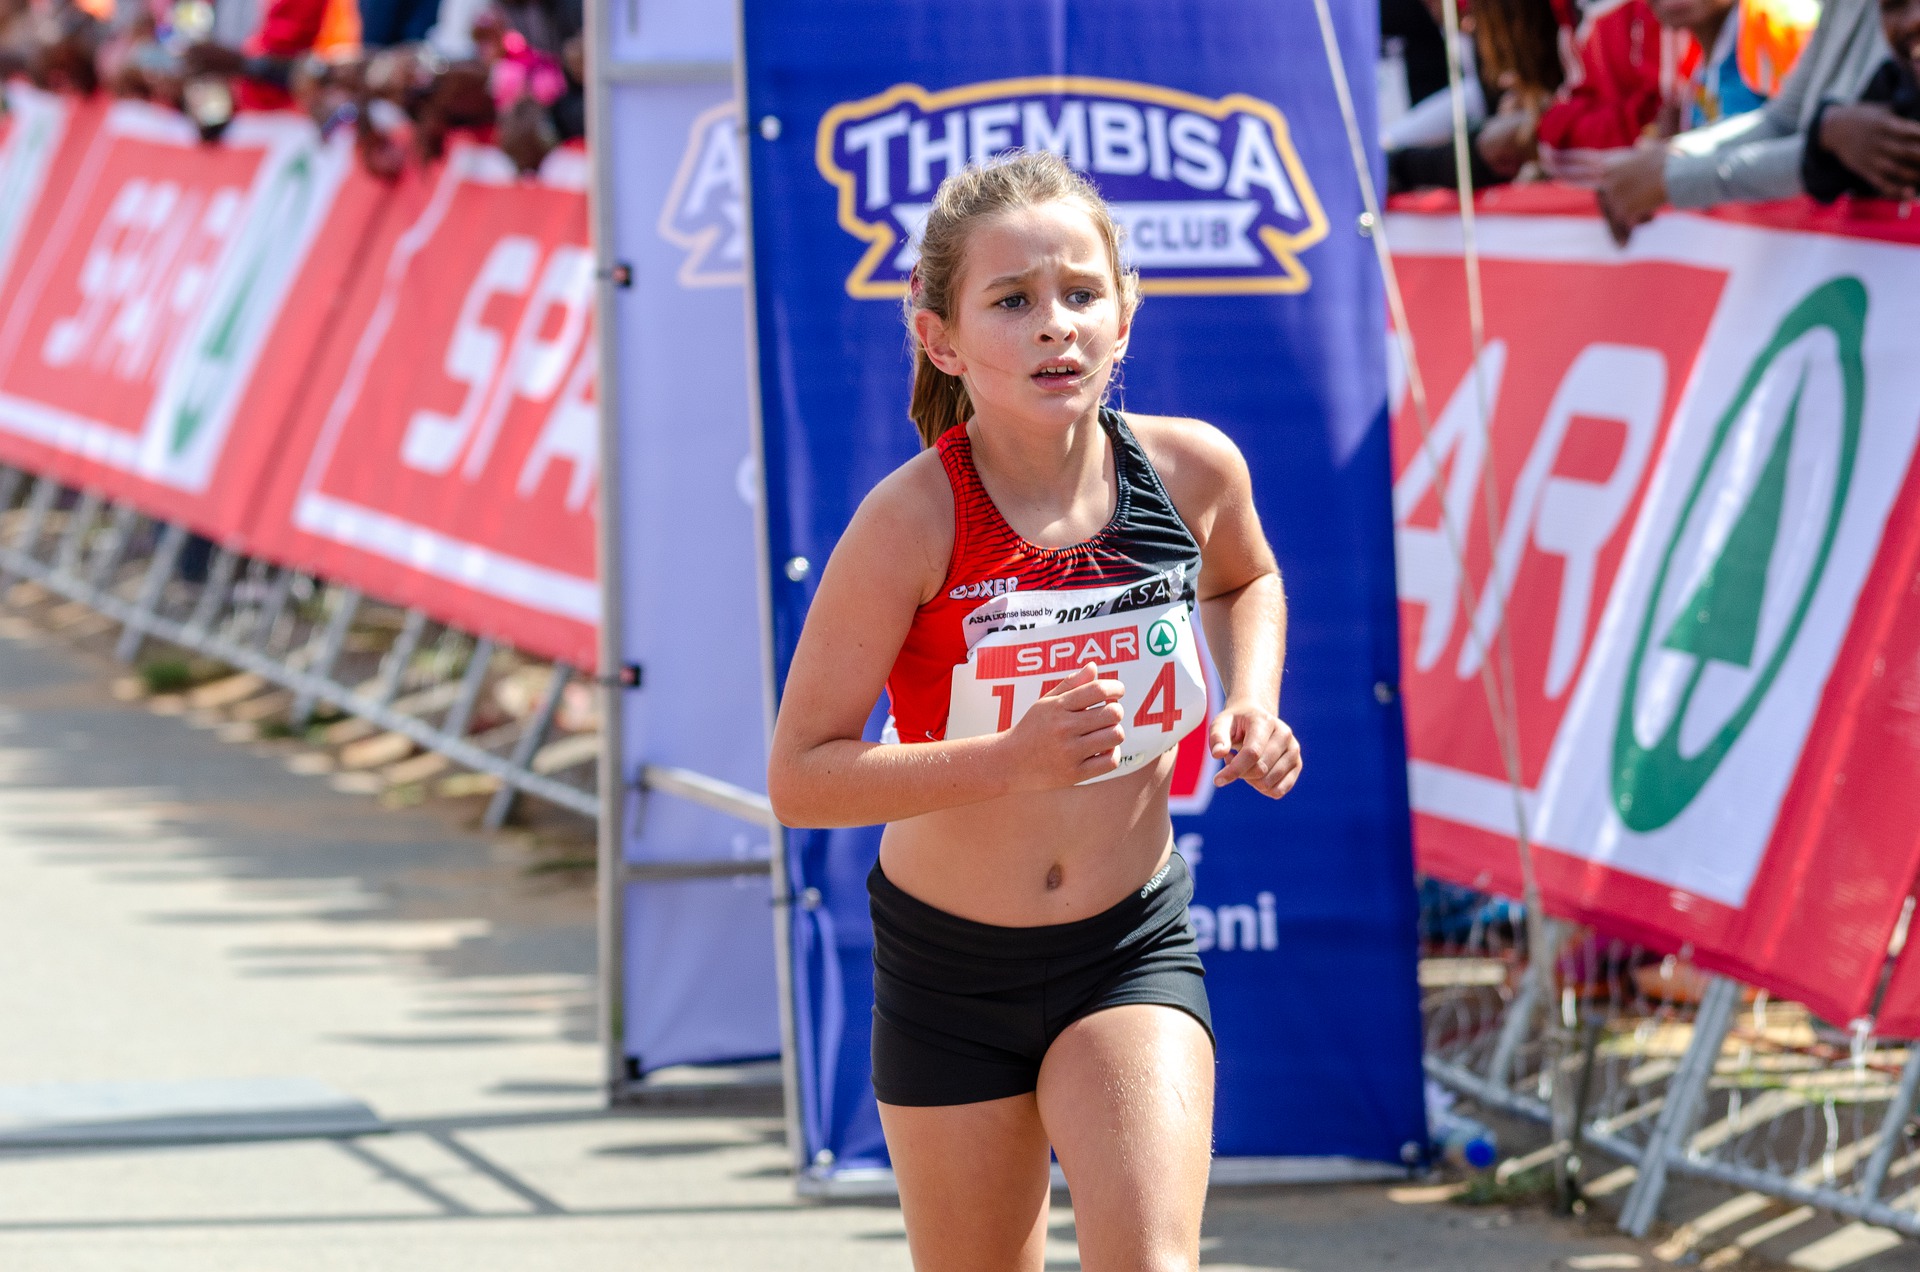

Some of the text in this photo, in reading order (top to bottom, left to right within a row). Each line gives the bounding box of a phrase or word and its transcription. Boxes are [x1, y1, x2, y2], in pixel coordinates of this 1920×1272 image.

[844, 100, 1302, 220] THEMBISA
[1132, 219, 1229, 250] CLUB
[402, 235, 601, 513] SPA
[1387, 332, 1668, 700] AR
[968, 615, 993, 625] ASA
[1019, 608, 1043, 617] issued
[1044, 608, 1053, 617] by
[1118, 580, 1166, 608] ASA
[1016, 631, 1137, 673] SPAR
[991, 661, 1183, 733] 14
